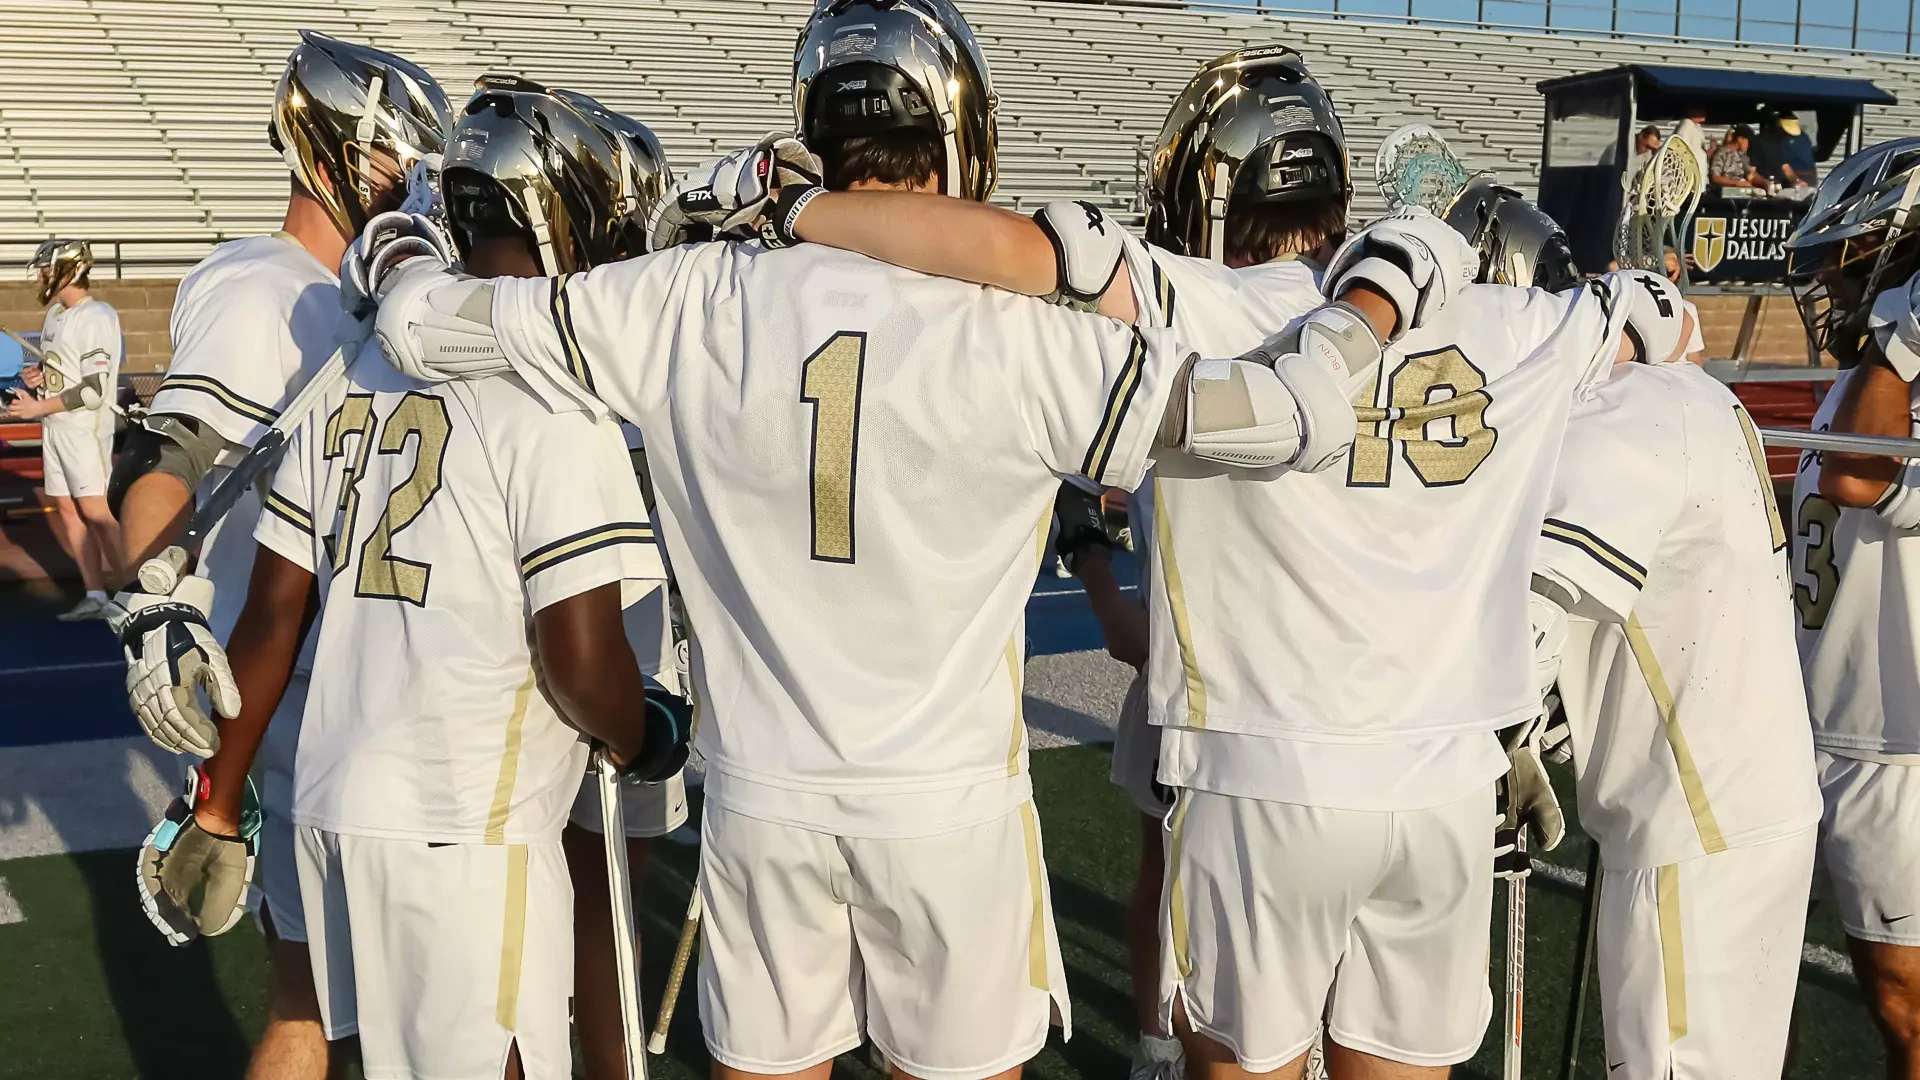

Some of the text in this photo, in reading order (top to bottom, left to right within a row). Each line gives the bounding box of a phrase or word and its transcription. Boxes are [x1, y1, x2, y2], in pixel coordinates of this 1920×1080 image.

[1235, 46, 1284, 58] cascade
[687, 190, 712, 202] STX
[1727, 218, 1791, 239] JESUIT
[1726, 240, 1787, 261] DALLAS
[439, 345, 494, 354] WARRIOR
[799, 330, 867, 564] 1
[322, 390, 453, 608] 32
